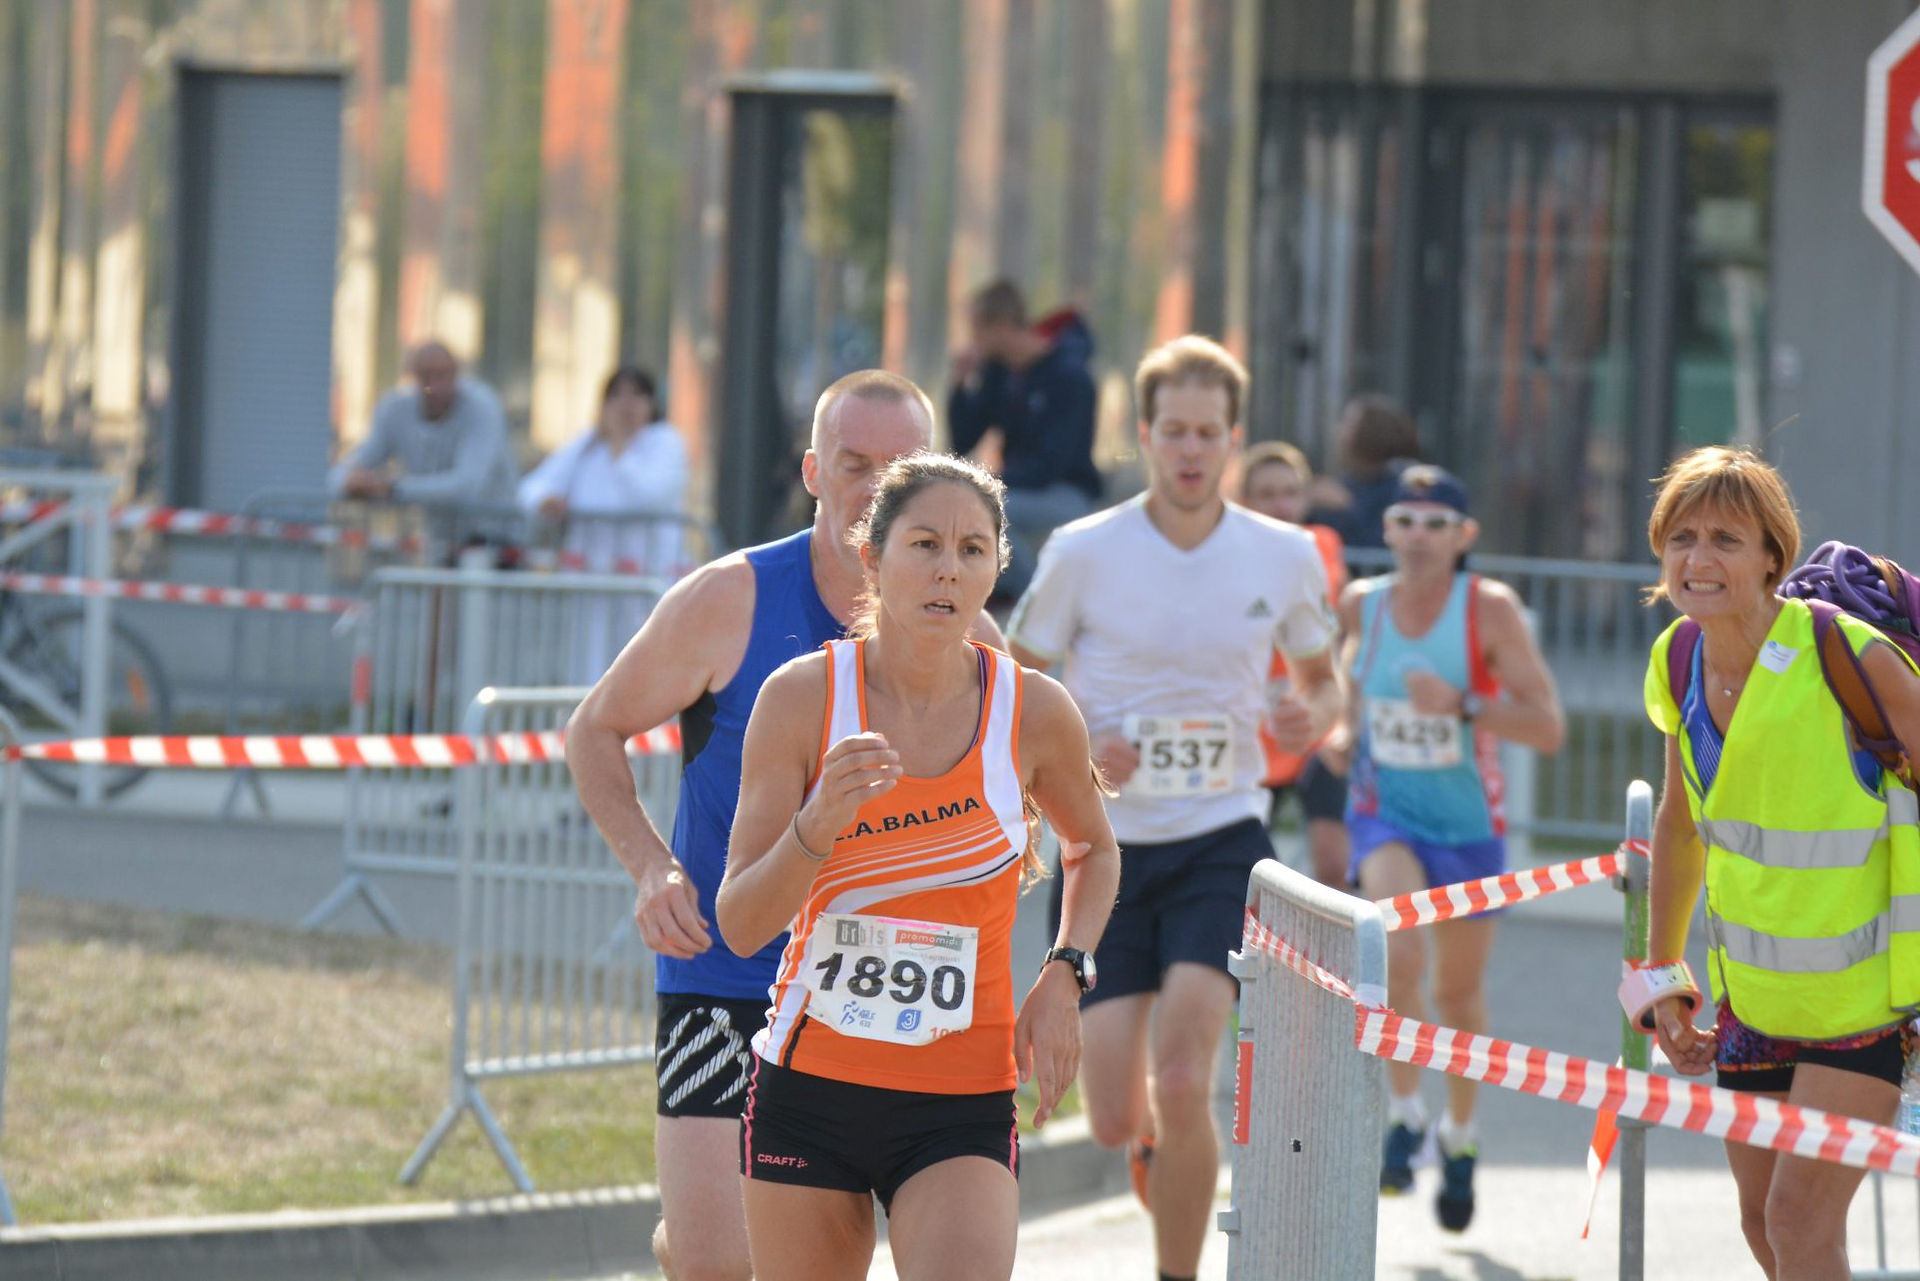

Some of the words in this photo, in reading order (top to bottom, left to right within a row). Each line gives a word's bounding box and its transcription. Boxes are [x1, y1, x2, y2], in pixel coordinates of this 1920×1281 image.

[835, 797, 981, 842] .A.BALMA
[815, 952, 966, 1011] 1890
[757, 1153, 796, 1167] CRAFT
